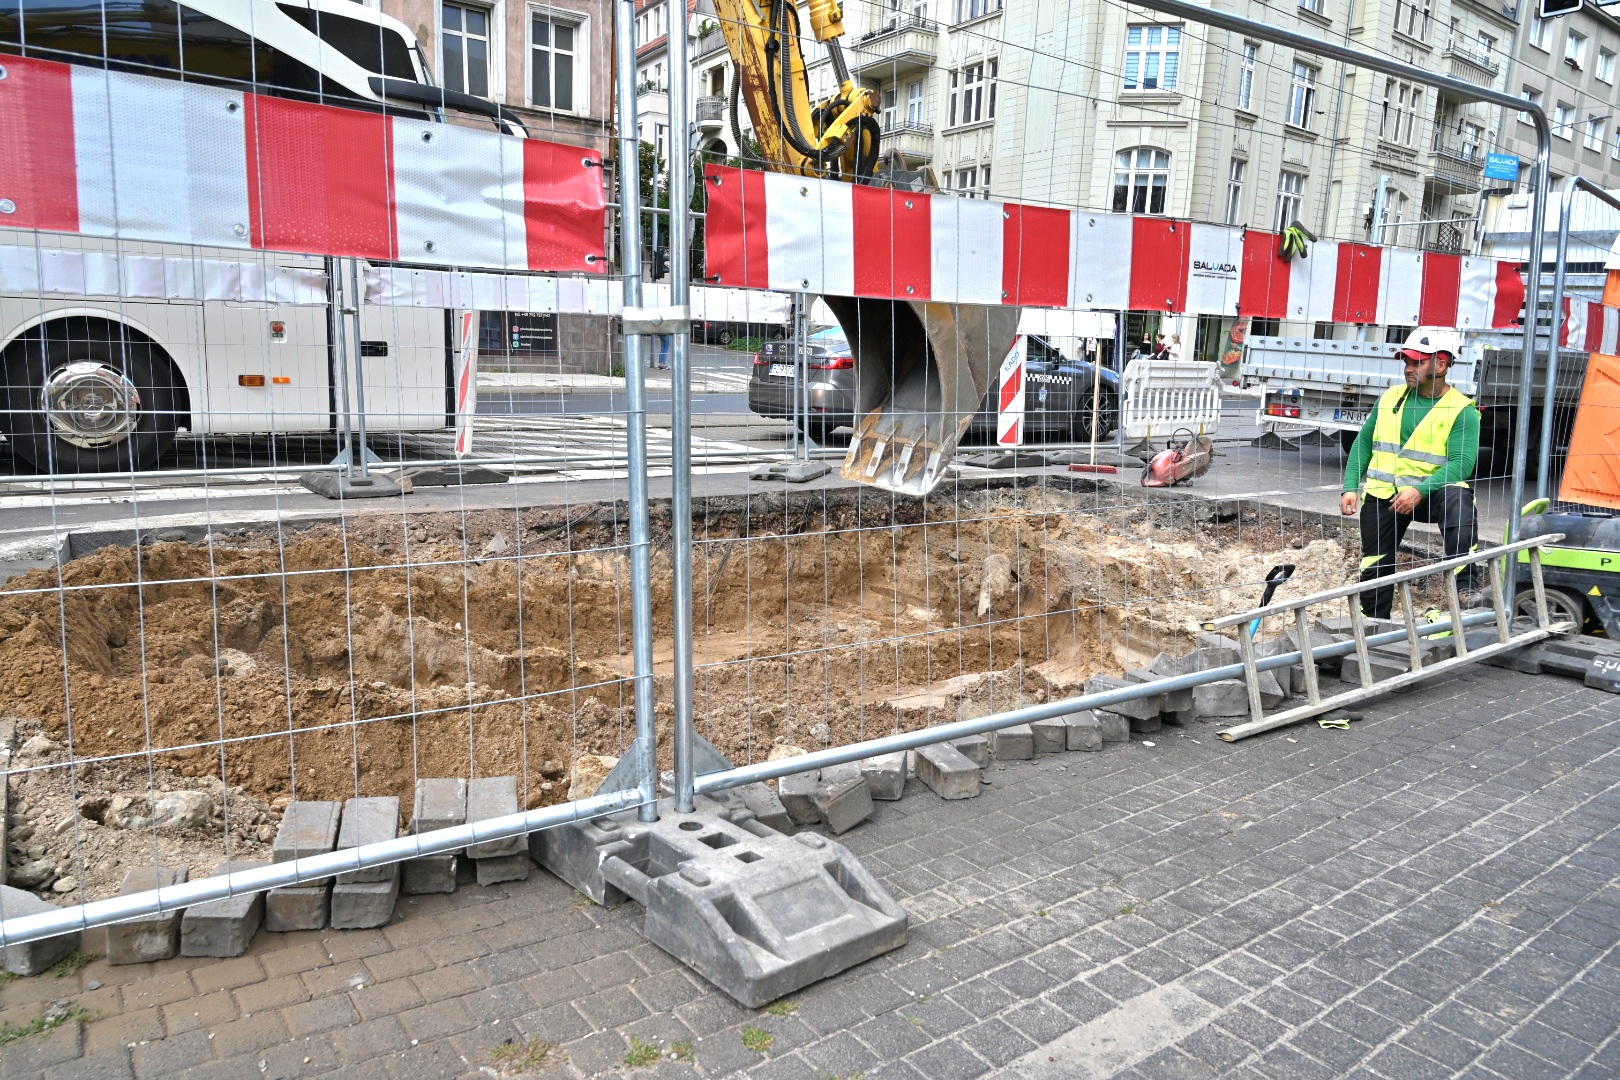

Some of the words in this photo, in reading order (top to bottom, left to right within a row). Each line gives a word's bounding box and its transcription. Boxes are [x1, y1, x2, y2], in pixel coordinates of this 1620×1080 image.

[1489, 156, 1516, 165] SALVADA
[1193, 261, 1237, 273] SALVADA
[1340, 410, 1354, 421] PN
